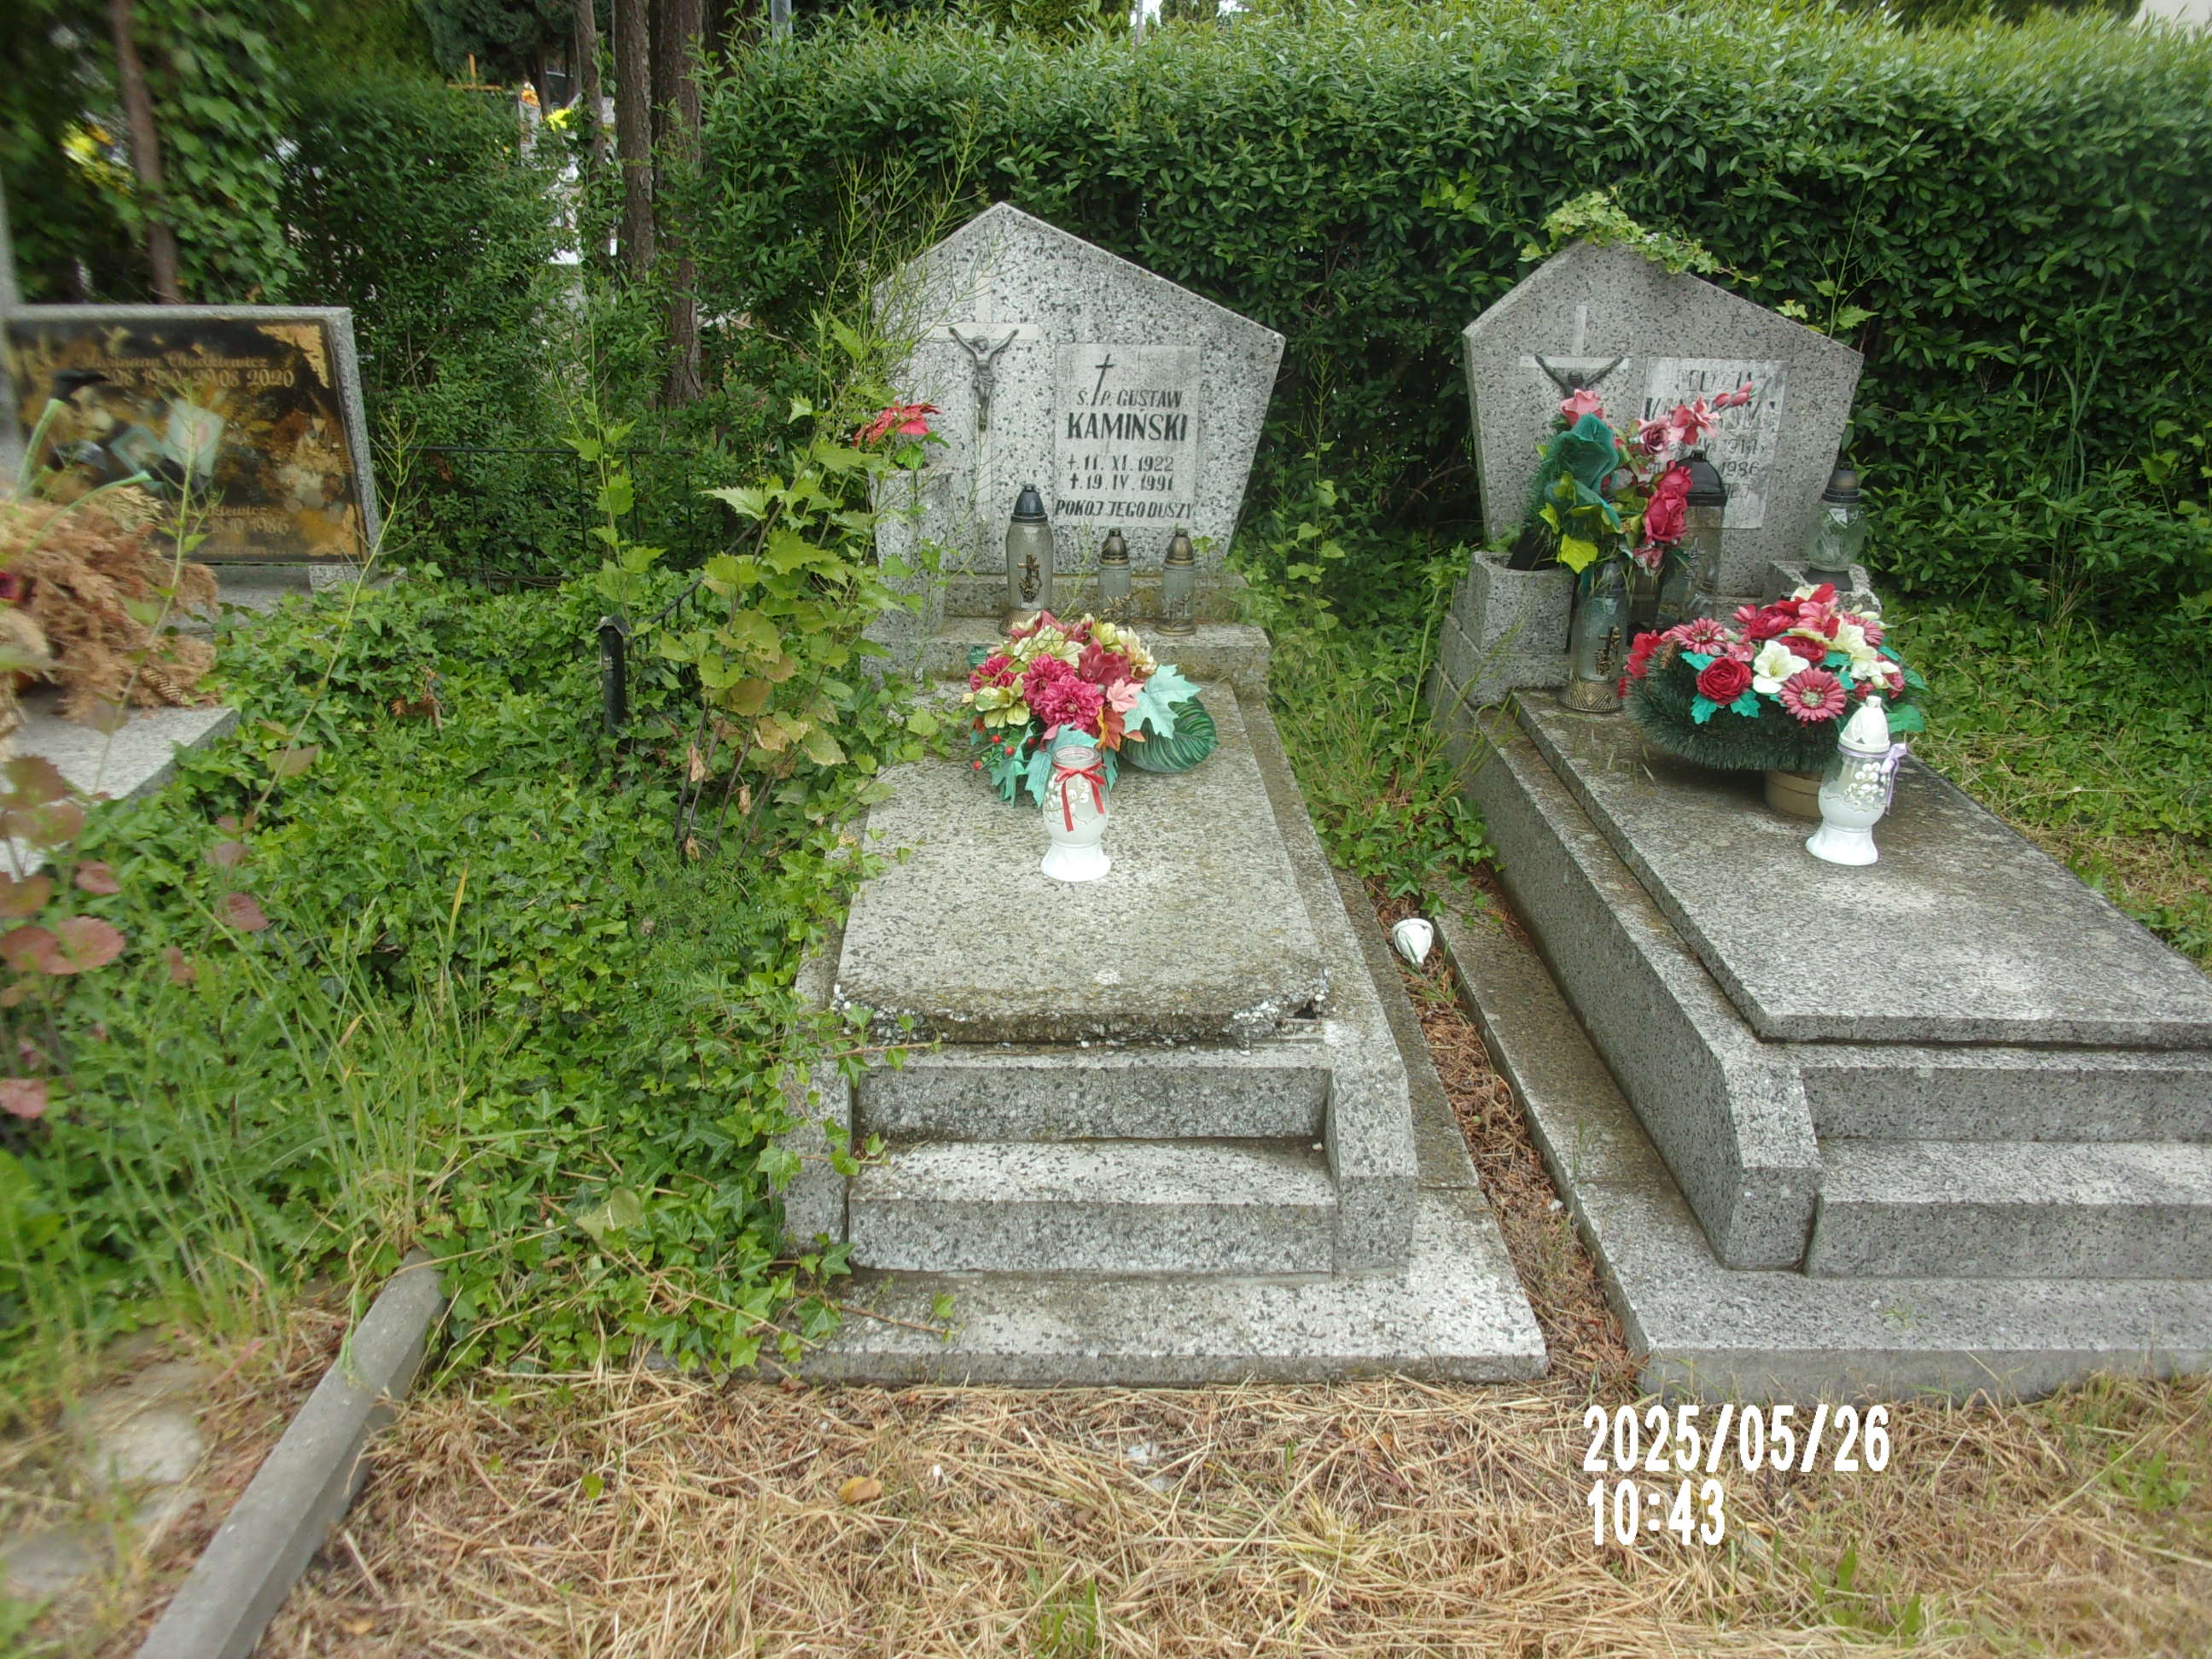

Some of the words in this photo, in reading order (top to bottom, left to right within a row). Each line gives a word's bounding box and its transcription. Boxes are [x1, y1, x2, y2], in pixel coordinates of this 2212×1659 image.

[247, 368, 295, 388] 2020
[1116, 389, 1184, 408] GUSTAW
[1067, 408, 1189, 442] KAMIŃSKI
[1138, 455, 1174, 472] 1922
[1140, 474, 1174, 492] 1991
[1106, 500, 1146, 518] JEGO
[1147, 501, 1195, 520] DUSZY
